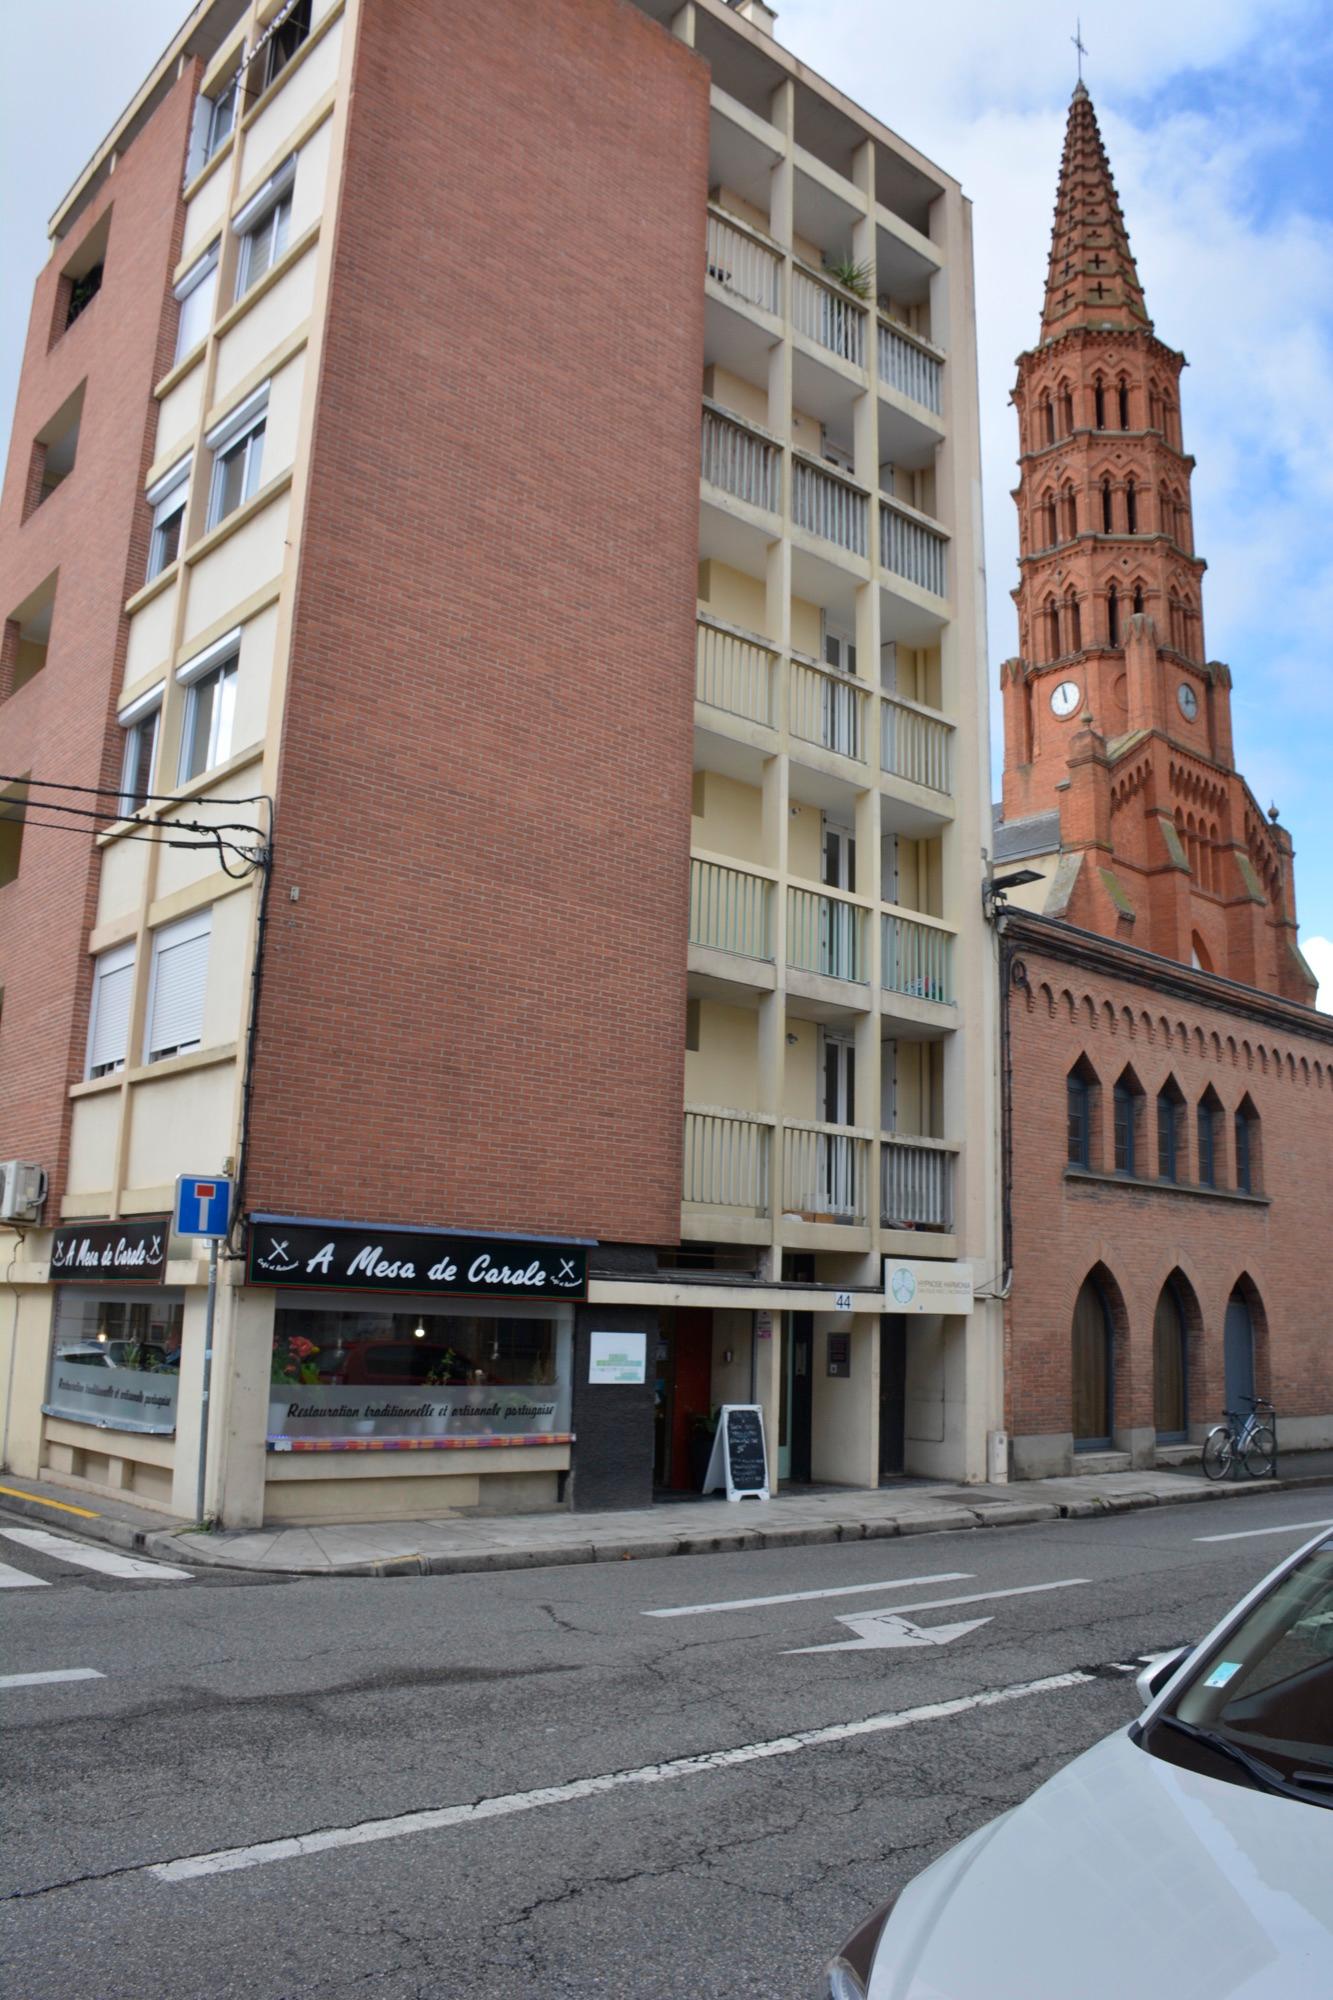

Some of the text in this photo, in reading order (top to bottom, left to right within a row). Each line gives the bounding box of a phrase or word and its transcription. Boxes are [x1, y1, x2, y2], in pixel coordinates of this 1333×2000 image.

[65, 1239, 76, 1266] A
[101, 1243, 113, 1266] de
[306, 1243, 547, 1286] A Mesa de Carole
[836, 1294, 851, 1309] 44
[287, 1402, 555, 1420] Restauration traditionnelle et artisanale portugaise
